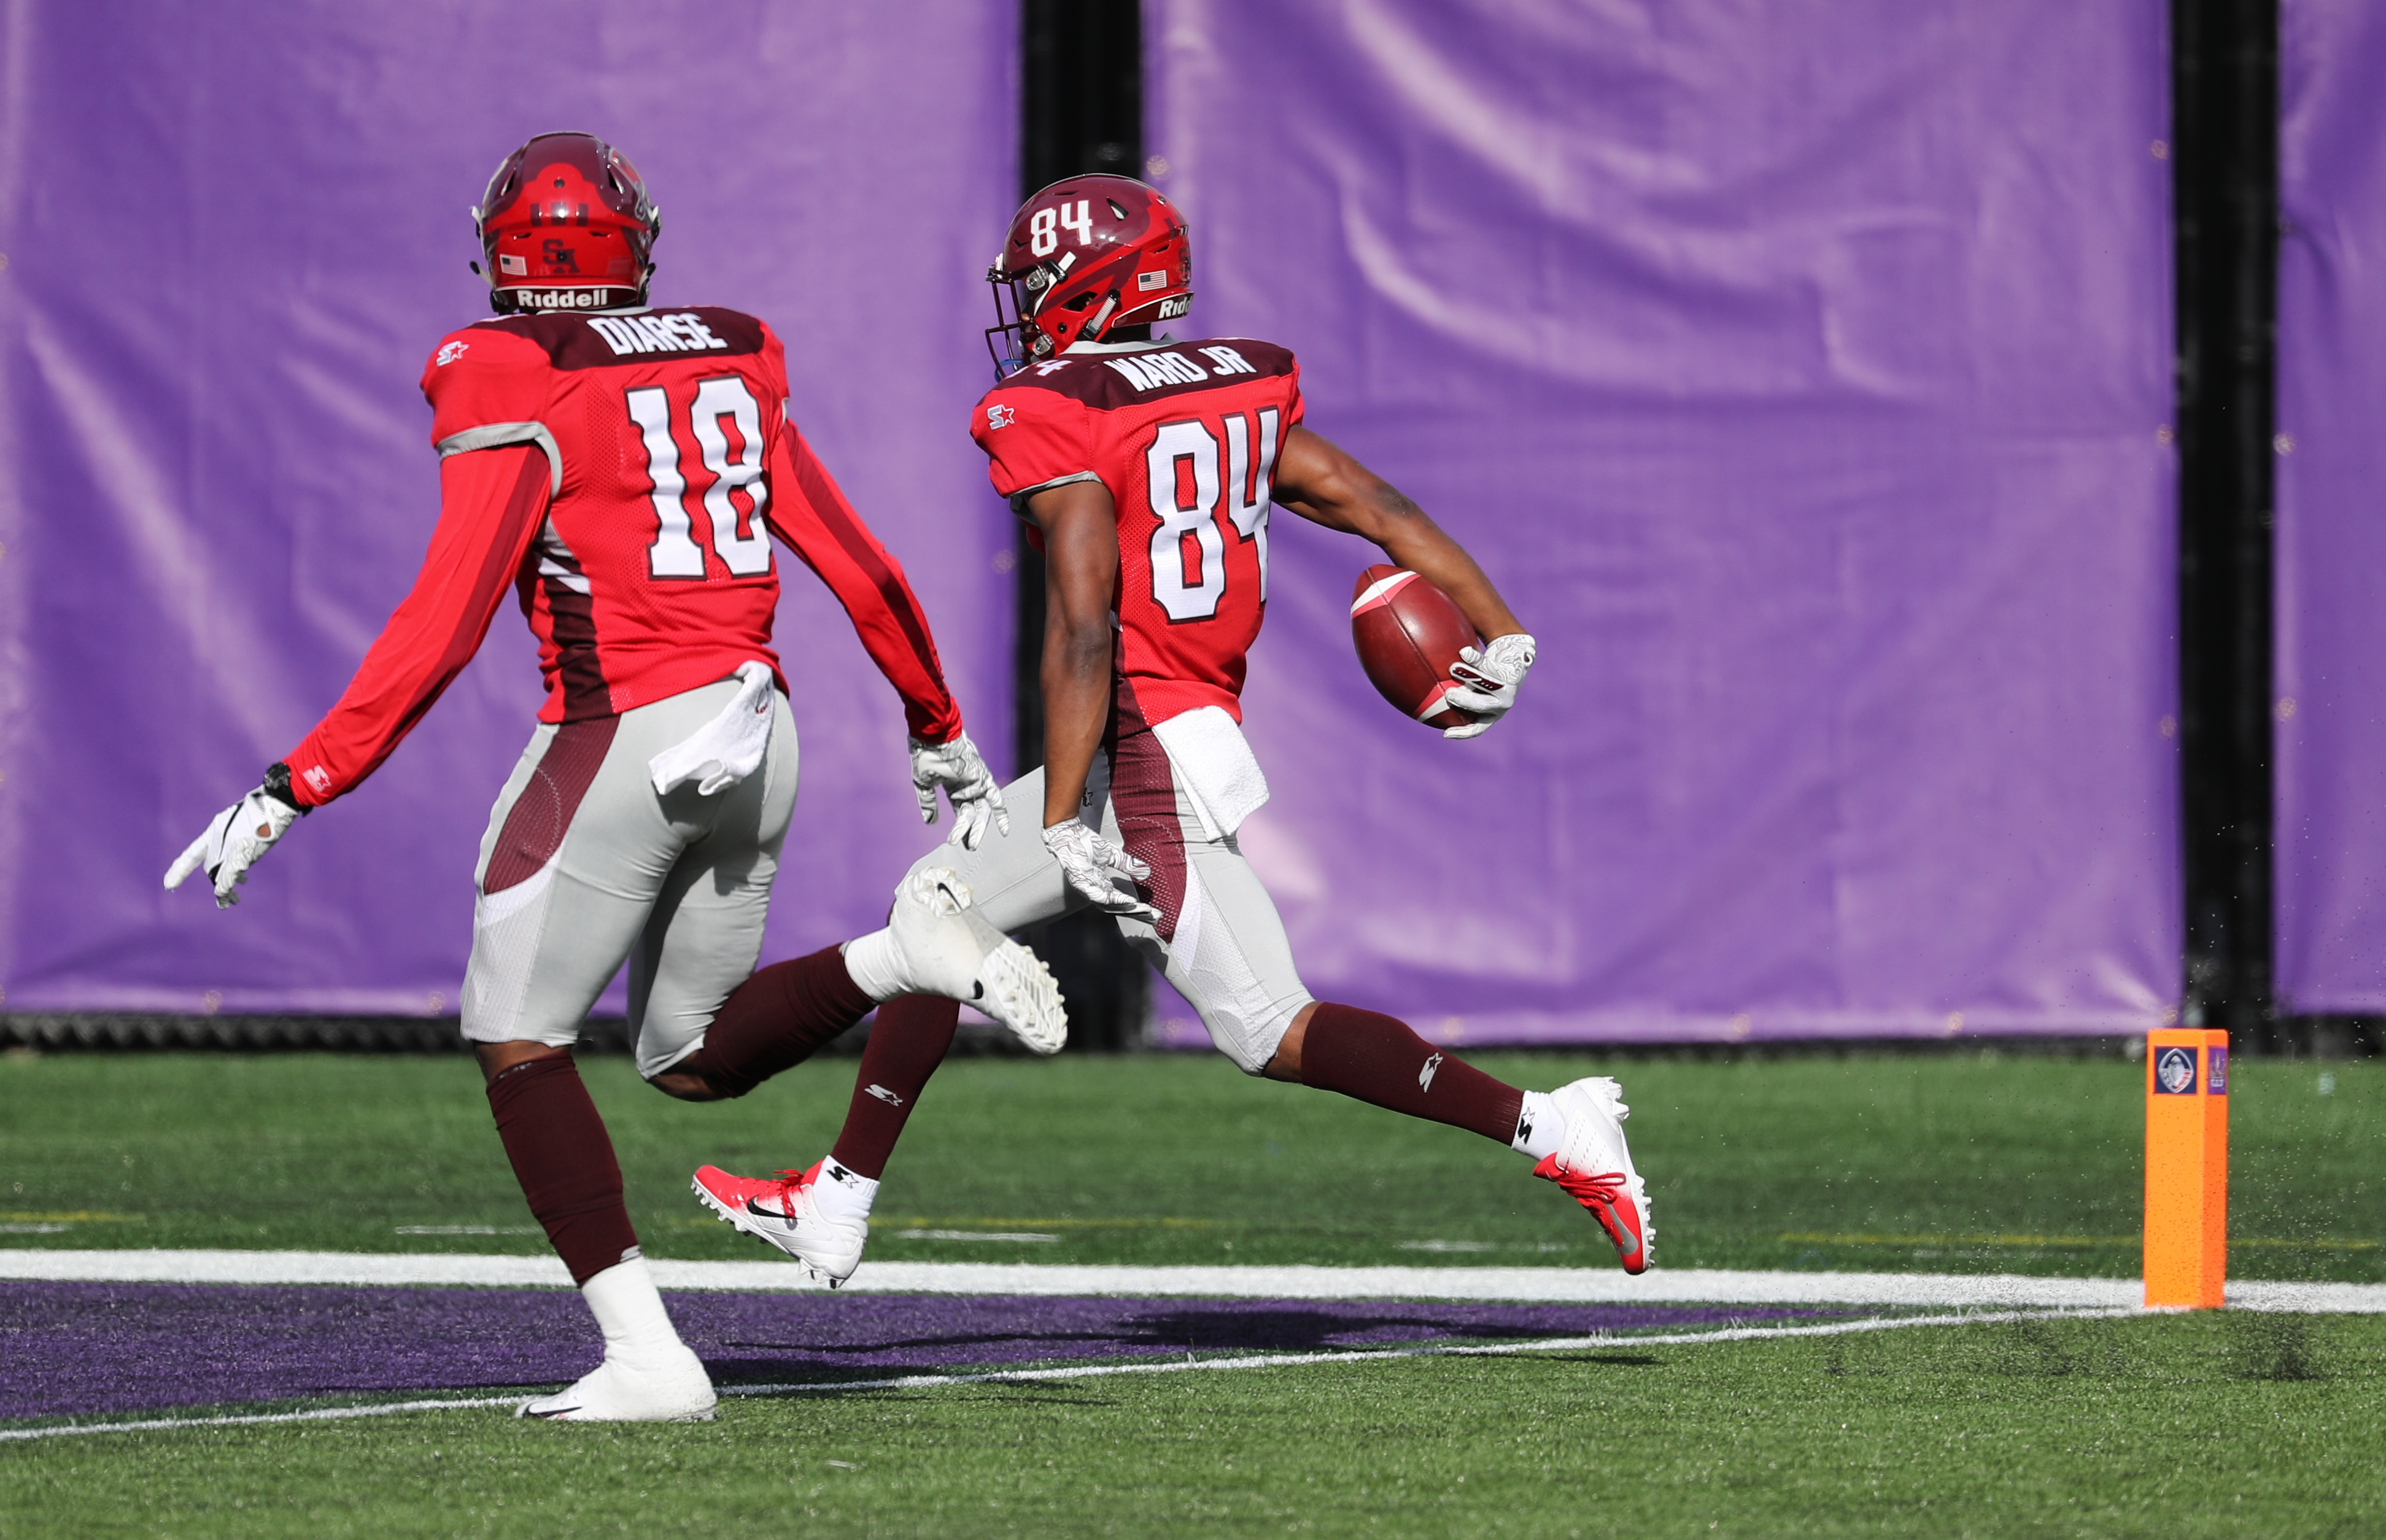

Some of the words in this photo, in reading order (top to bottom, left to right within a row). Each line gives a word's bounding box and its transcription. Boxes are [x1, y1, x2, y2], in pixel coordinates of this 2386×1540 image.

[1031, 199, 1093, 258] 84
[517, 288, 608, 308] Riddell
[586, 312, 729, 356] DIARSE
[1103, 351, 1209, 392] WARD
[1197, 345, 1257, 376] JR
[624, 374, 772, 581] 18
[1145, 404, 1279, 624] 84
